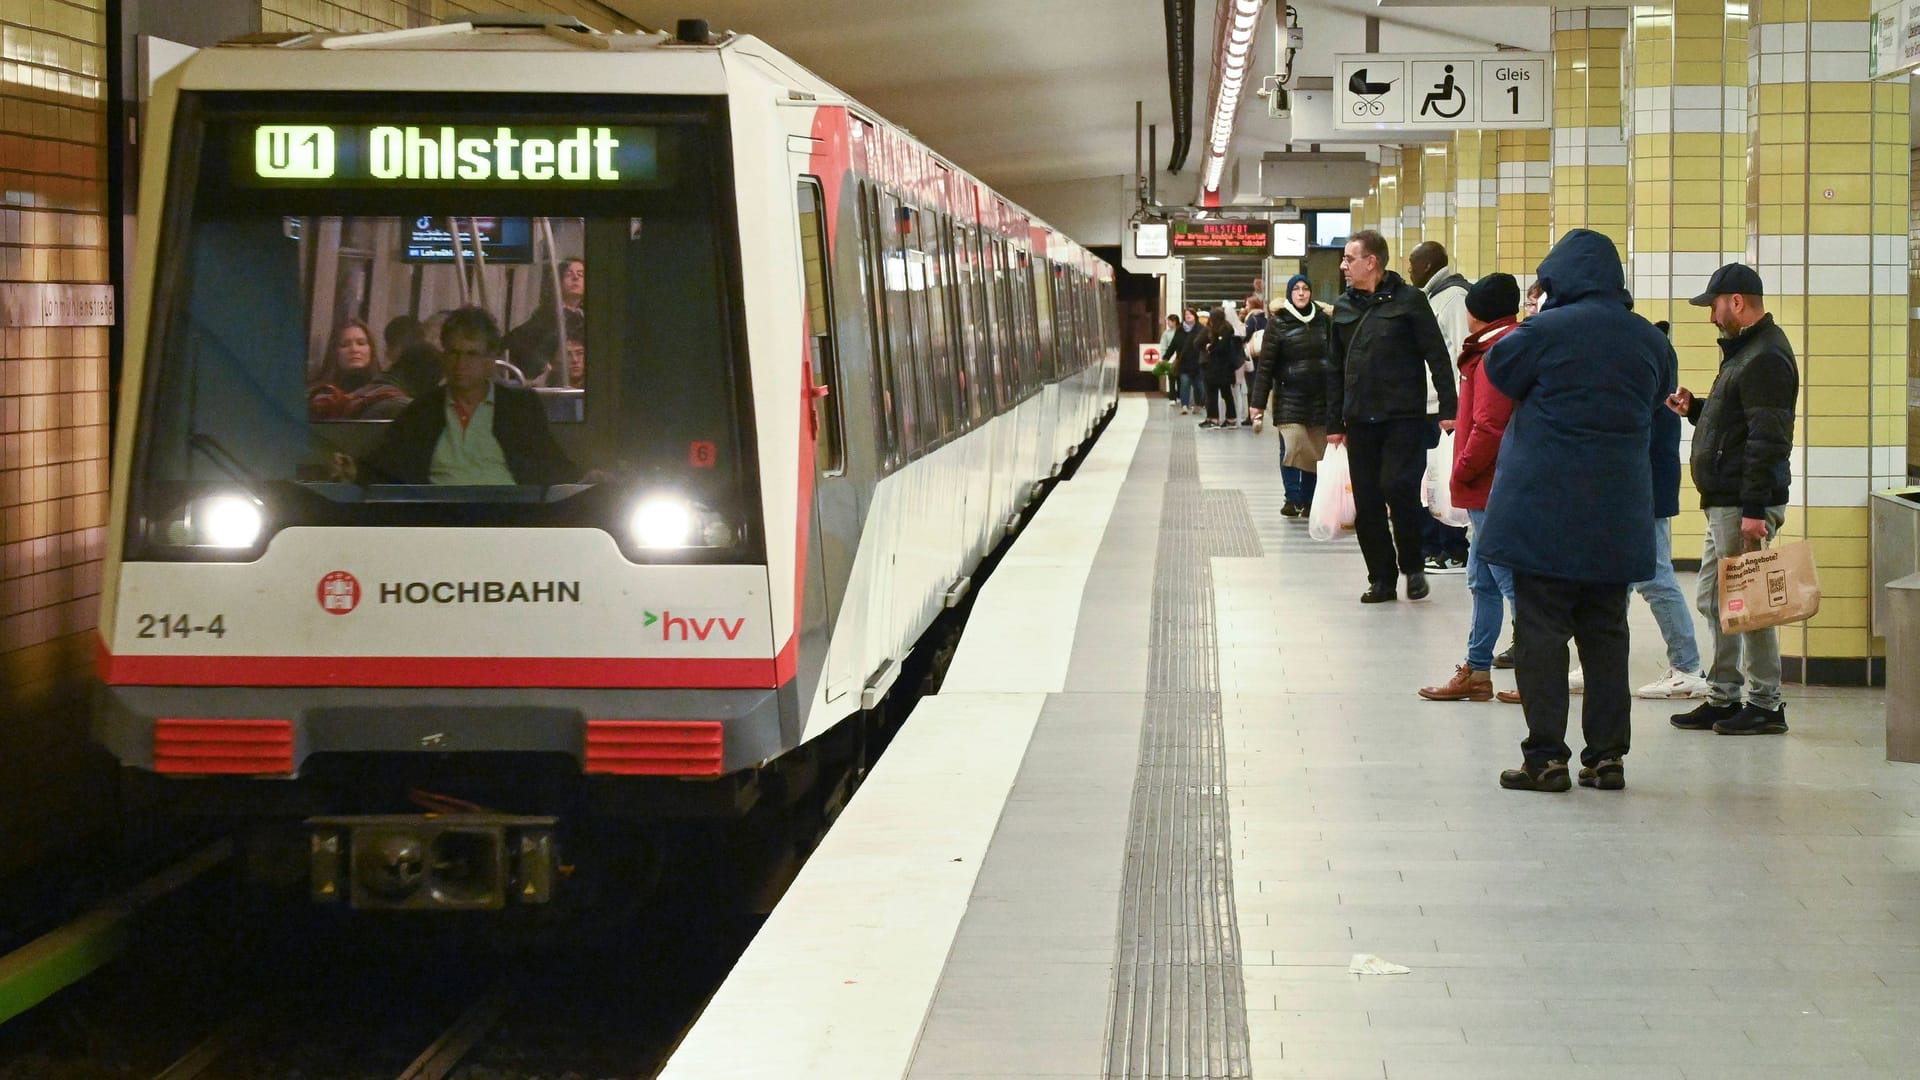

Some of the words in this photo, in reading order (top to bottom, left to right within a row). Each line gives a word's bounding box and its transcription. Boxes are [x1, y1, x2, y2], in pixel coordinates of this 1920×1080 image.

[1496, 67, 1530, 81] Gleis
[1507, 86, 1519, 114] 1
[269, 131, 320, 170] U1
[370, 126, 619, 180] Ohlstedt
[1203, 224, 1248, 233] OHLSTEDT
[697, 445, 708, 462] 6
[1745, 553, 1778, 565] Angebote?
[379, 581, 581, 603] HOCHBAHN
[136, 613, 226, 638] 214-4
